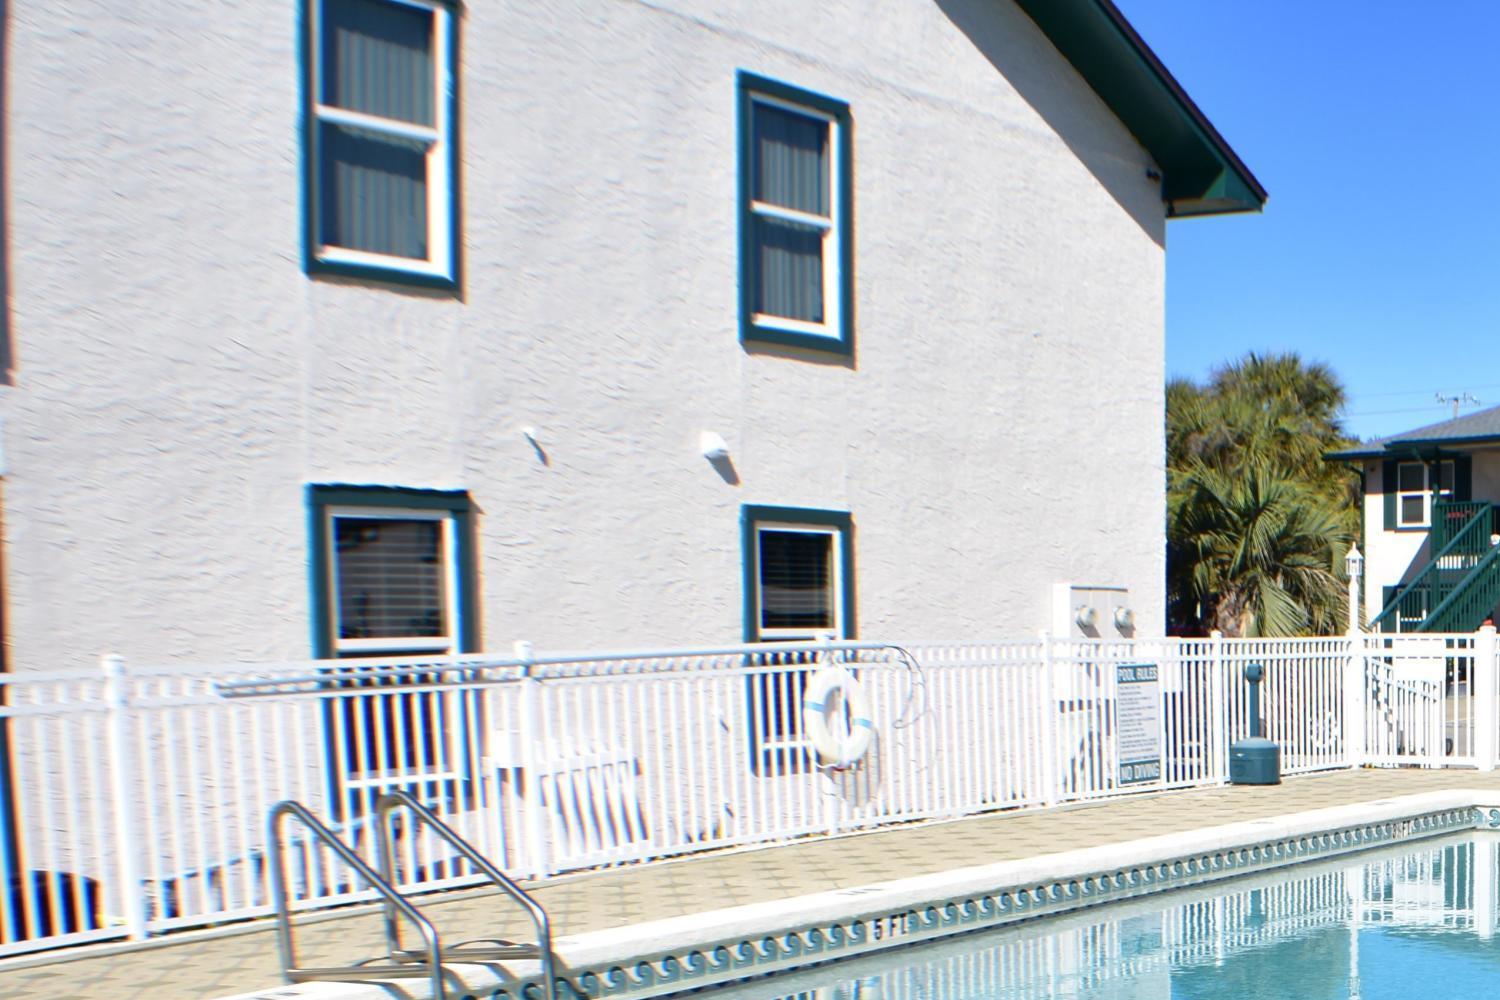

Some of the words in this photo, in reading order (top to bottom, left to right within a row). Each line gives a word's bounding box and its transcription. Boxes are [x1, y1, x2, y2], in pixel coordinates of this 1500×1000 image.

[1118, 667, 1137, 681] POOL
[1137, 665, 1158, 680] RULES
[1120, 766, 1133, 782] NO
[1134, 762, 1160, 780] DIVING
[873, 918, 883, 941] 5
[888, 912, 907, 937] FT
